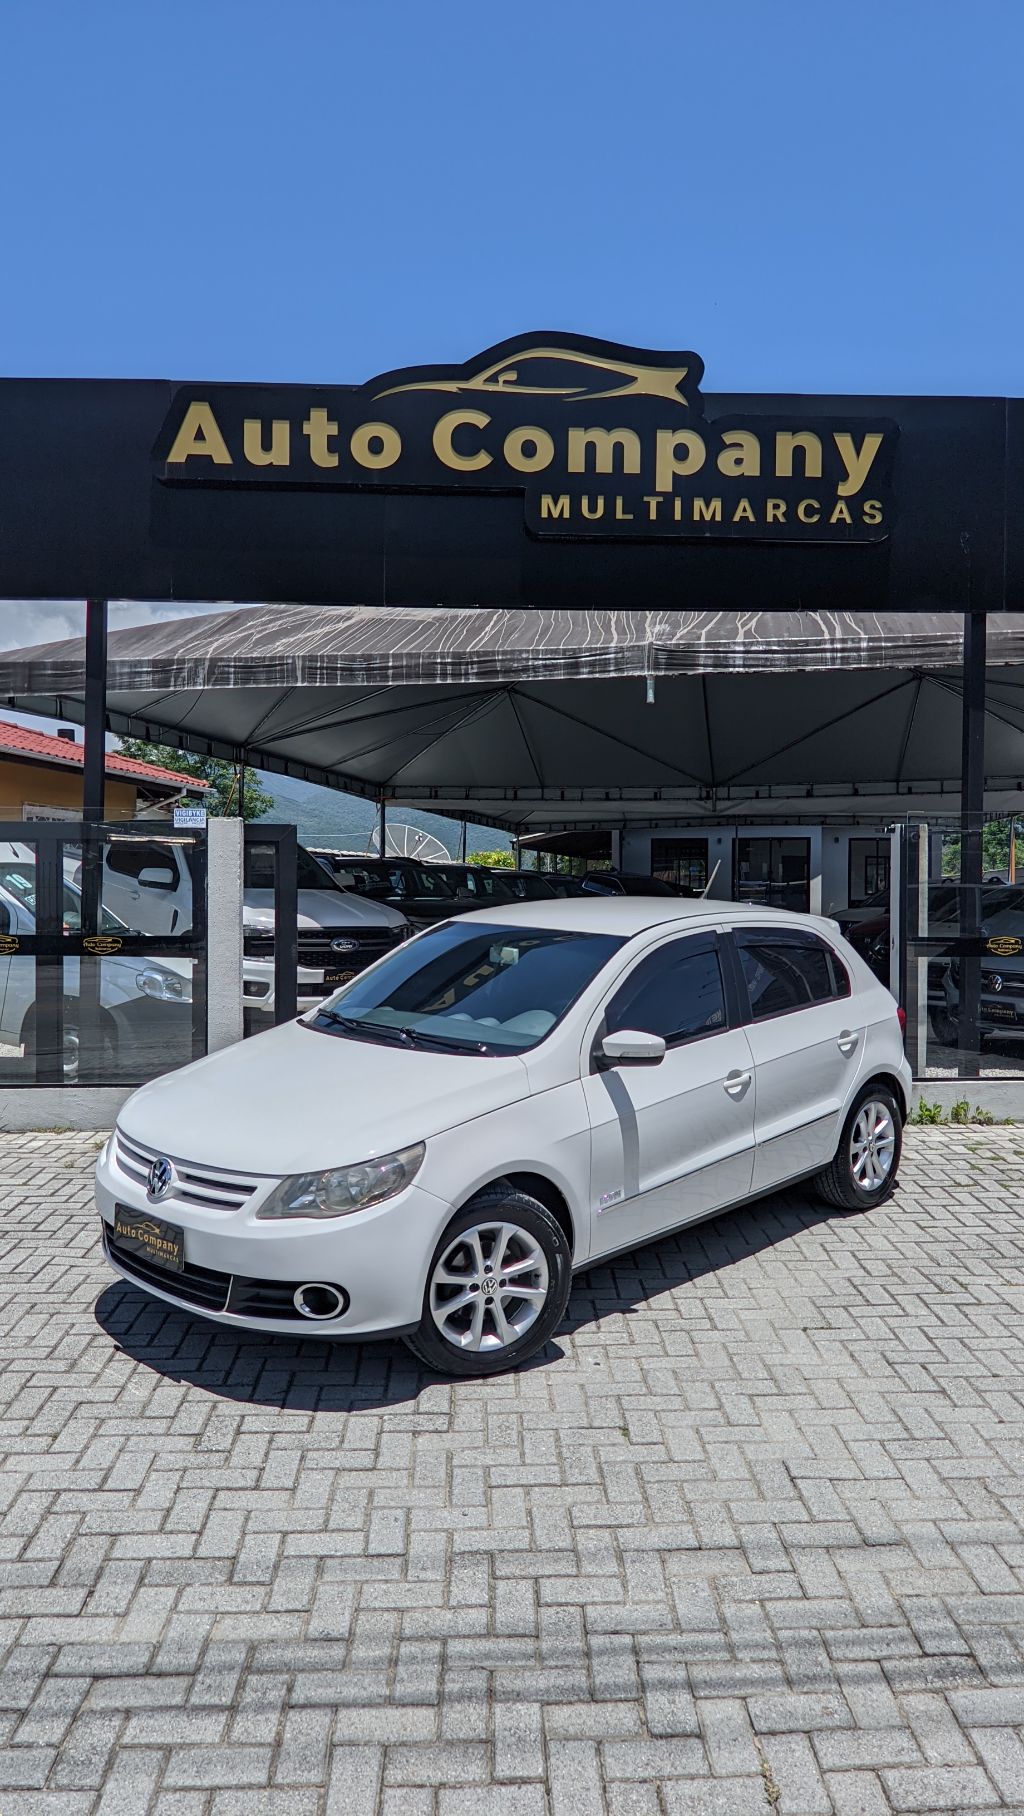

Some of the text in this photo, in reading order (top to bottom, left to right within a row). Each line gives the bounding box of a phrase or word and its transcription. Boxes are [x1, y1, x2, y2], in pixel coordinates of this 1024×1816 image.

[166, 400, 884, 497] Auto Company
[540, 494, 884, 525] MULTIMARCAS
[116, 1221, 179, 1256] Auto Company
[146, 1246, 179, 1263] MULTIMARCAS
